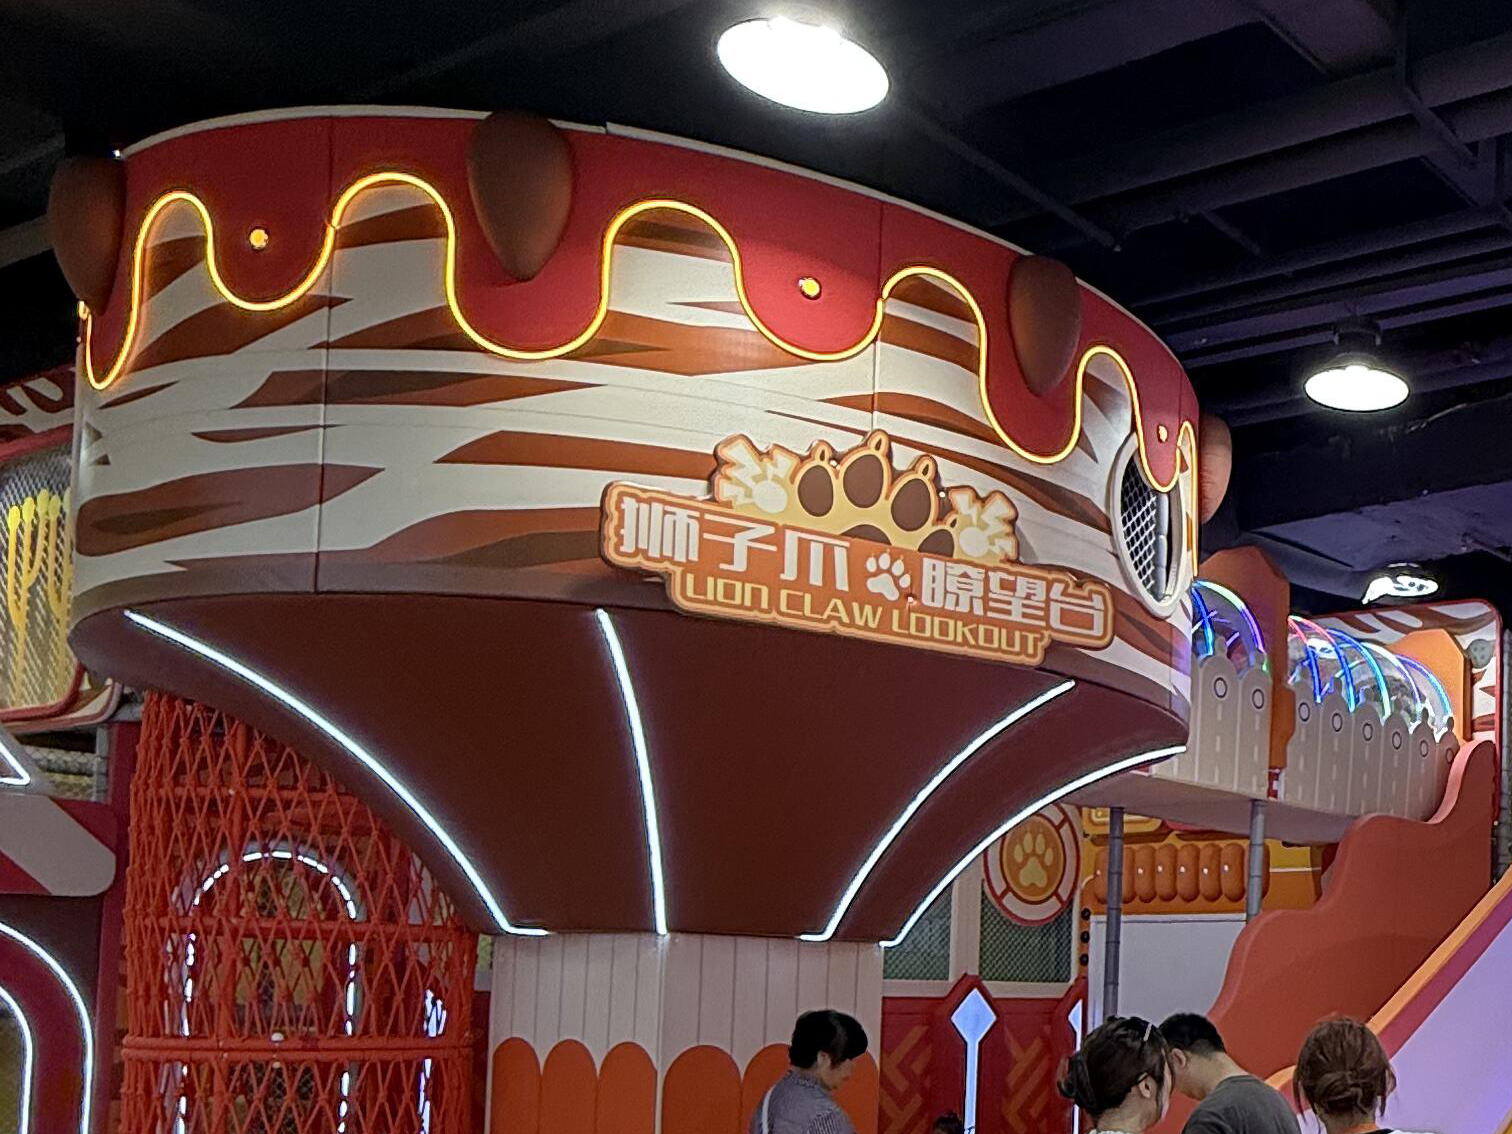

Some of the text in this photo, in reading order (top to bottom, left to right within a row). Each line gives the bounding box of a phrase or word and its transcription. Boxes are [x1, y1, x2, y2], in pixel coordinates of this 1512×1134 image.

[686, 572, 1041, 655] LION CLAW LOOKOUT
[921, 556, 1105, 637] 瞭望台
